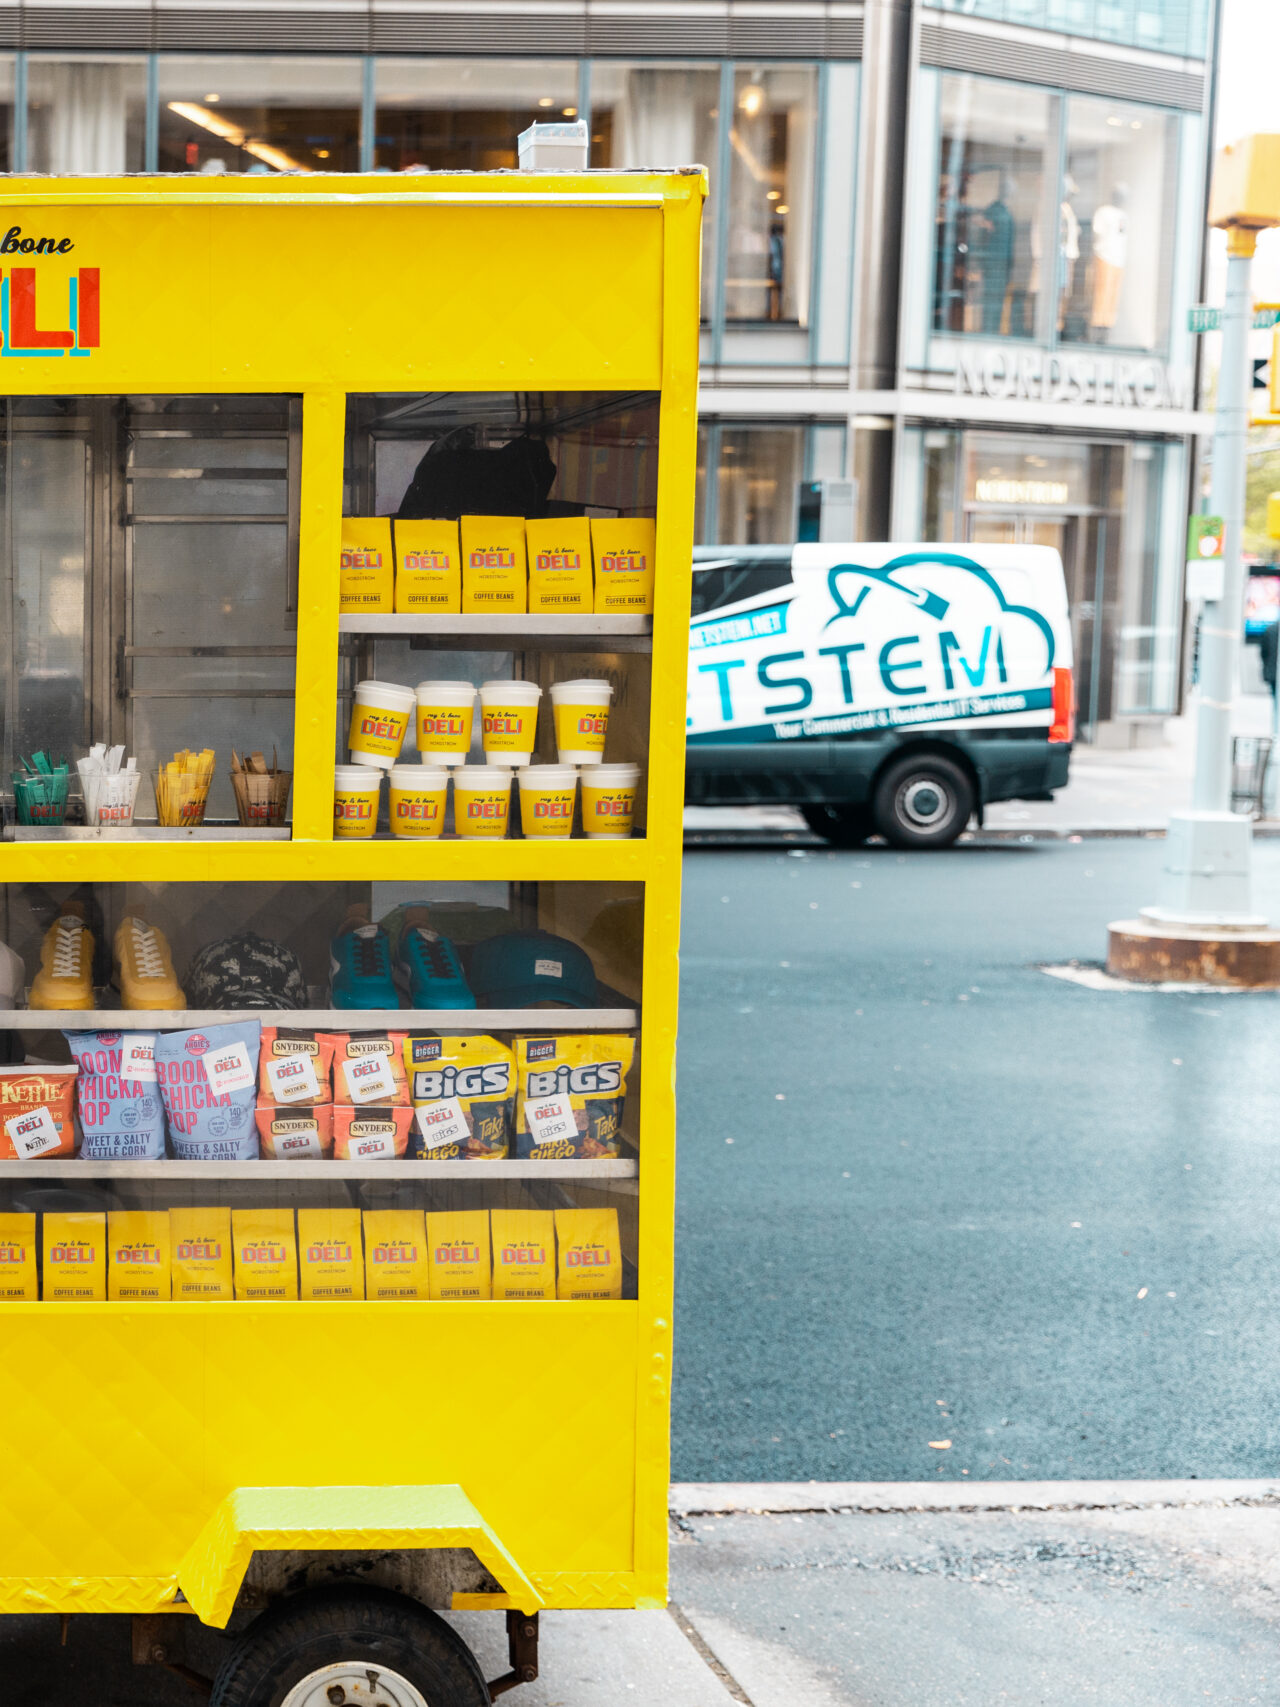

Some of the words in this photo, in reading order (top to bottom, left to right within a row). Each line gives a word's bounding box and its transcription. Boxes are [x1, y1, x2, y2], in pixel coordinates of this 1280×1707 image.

[340, 554, 383, 570] DELI
[404, 556, 450, 571] DELI
[469, 553, 515, 569] DELI
[536, 554, 581, 571] DELI
[601, 556, 646, 573] DELI
[686, 626, 1008, 727] TSTEM
[773, 721, 803, 739] Your
[802, 711, 876, 735] Commercial
[889, 701, 954, 724] Residential
[971, 694, 1027, 716] Services
[361, 719, 402, 740] DELI
[423, 719, 464, 736] DELI
[483, 718, 522, 735] DELI
[30, 805, 62, 818] DELI
[98, 807, 131, 820] DELI
[333, 803, 372, 819] DELI
[396, 803, 438, 820] DELI
[467, 803, 508, 819] DELI
[275, 1042, 316, 1052] SNYDER'S
[349, 1043, 391, 1053] SNYDER'S
[416, 1046, 440, 1057] BIGGER
[214, 1058, 242, 1073] DELI
[276, 1063, 305, 1080] DELI
[352, 1062, 381, 1079] DELI
[413, 1062, 510, 1100] BiGS
[527, 1062, 622, 1098] BiGS
[0, 1076, 64, 1104] KETTLE
[426, 1109, 454, 1126] DELI
[534, 1106, 562, 1120] DELI
[16, 1118, 44, 1136] DELI
[274, 1121, 315, 1130] SNYDER'S
[352, 1123, 393, 1133] SNYDER'S
[86, 1135, 110, 1146] WEET
[114, 1135, 121, 1146] &
[124, 1133, 151, 1145] SALTY
[204, 1143, 210, 1153] &
[213, 1141, 240, 1153] SALTY
[282, 1138, 311, 1150] DELI
[122, 1145, 146, 1157] CORN
[357, 1142, 385, 1156] DELI
[50, 1247, 95, 1263] DELI
[116, 1249, 161, 1264] DELI
[178, 1243, 222, 1260] DELI
[241, 1247, 287, 1263] DELI
[307, 1245, 353, 1263] DELI
[373, 1247, 418, 1263] DELI
[435, 1247, 481, 1264] DELI
[501, 1248, 546, 1265] DELI
[566, 1250, 611, 1267] DELI
